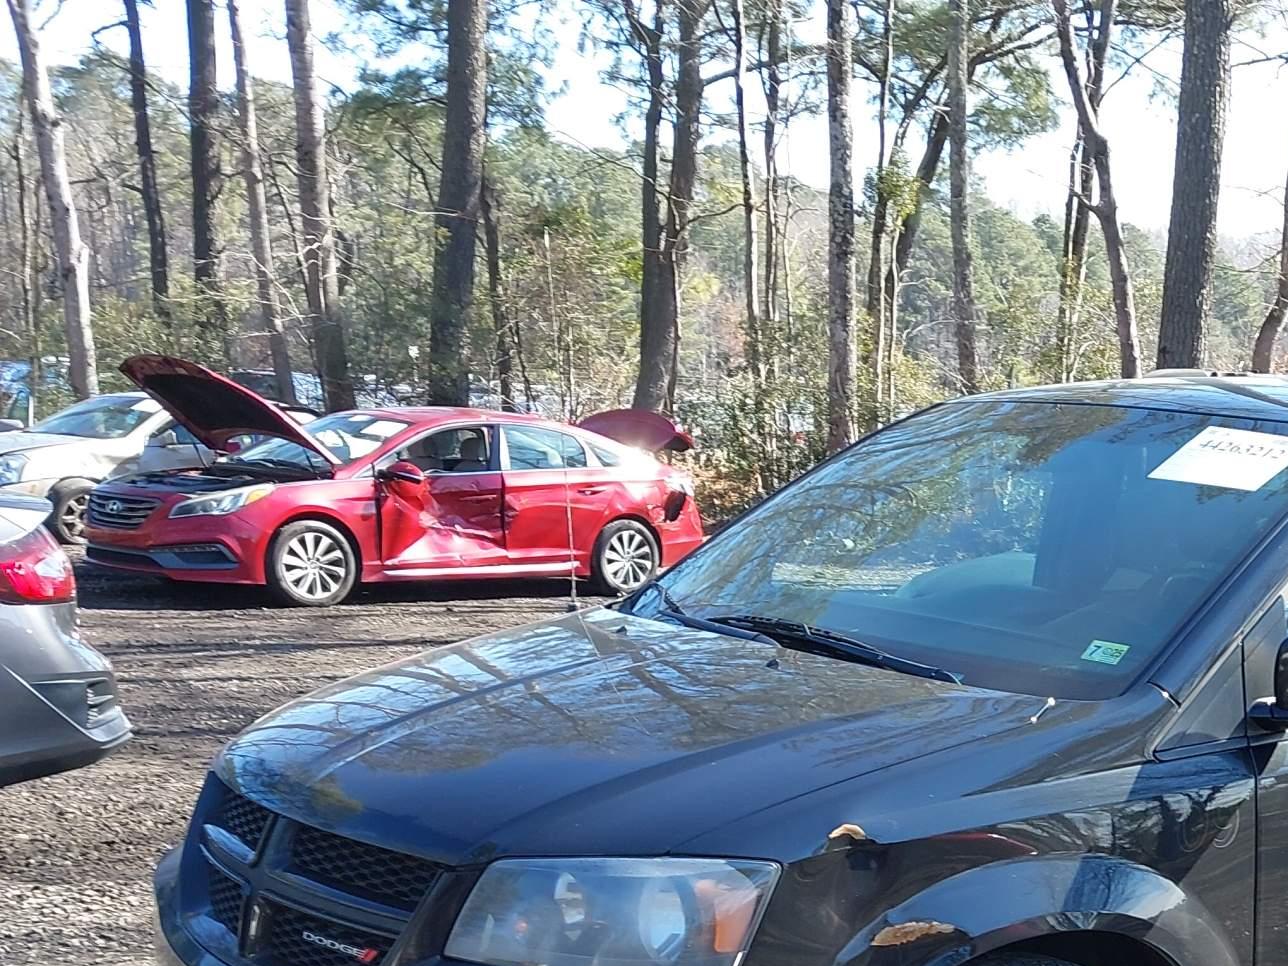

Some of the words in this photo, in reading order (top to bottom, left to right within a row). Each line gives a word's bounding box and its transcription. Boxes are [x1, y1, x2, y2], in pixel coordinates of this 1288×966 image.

[1200, 439, 1286, 460] 44263212
[1088, 645, 1102, 657] 7
[302, 931, 366, 960] DODGE
